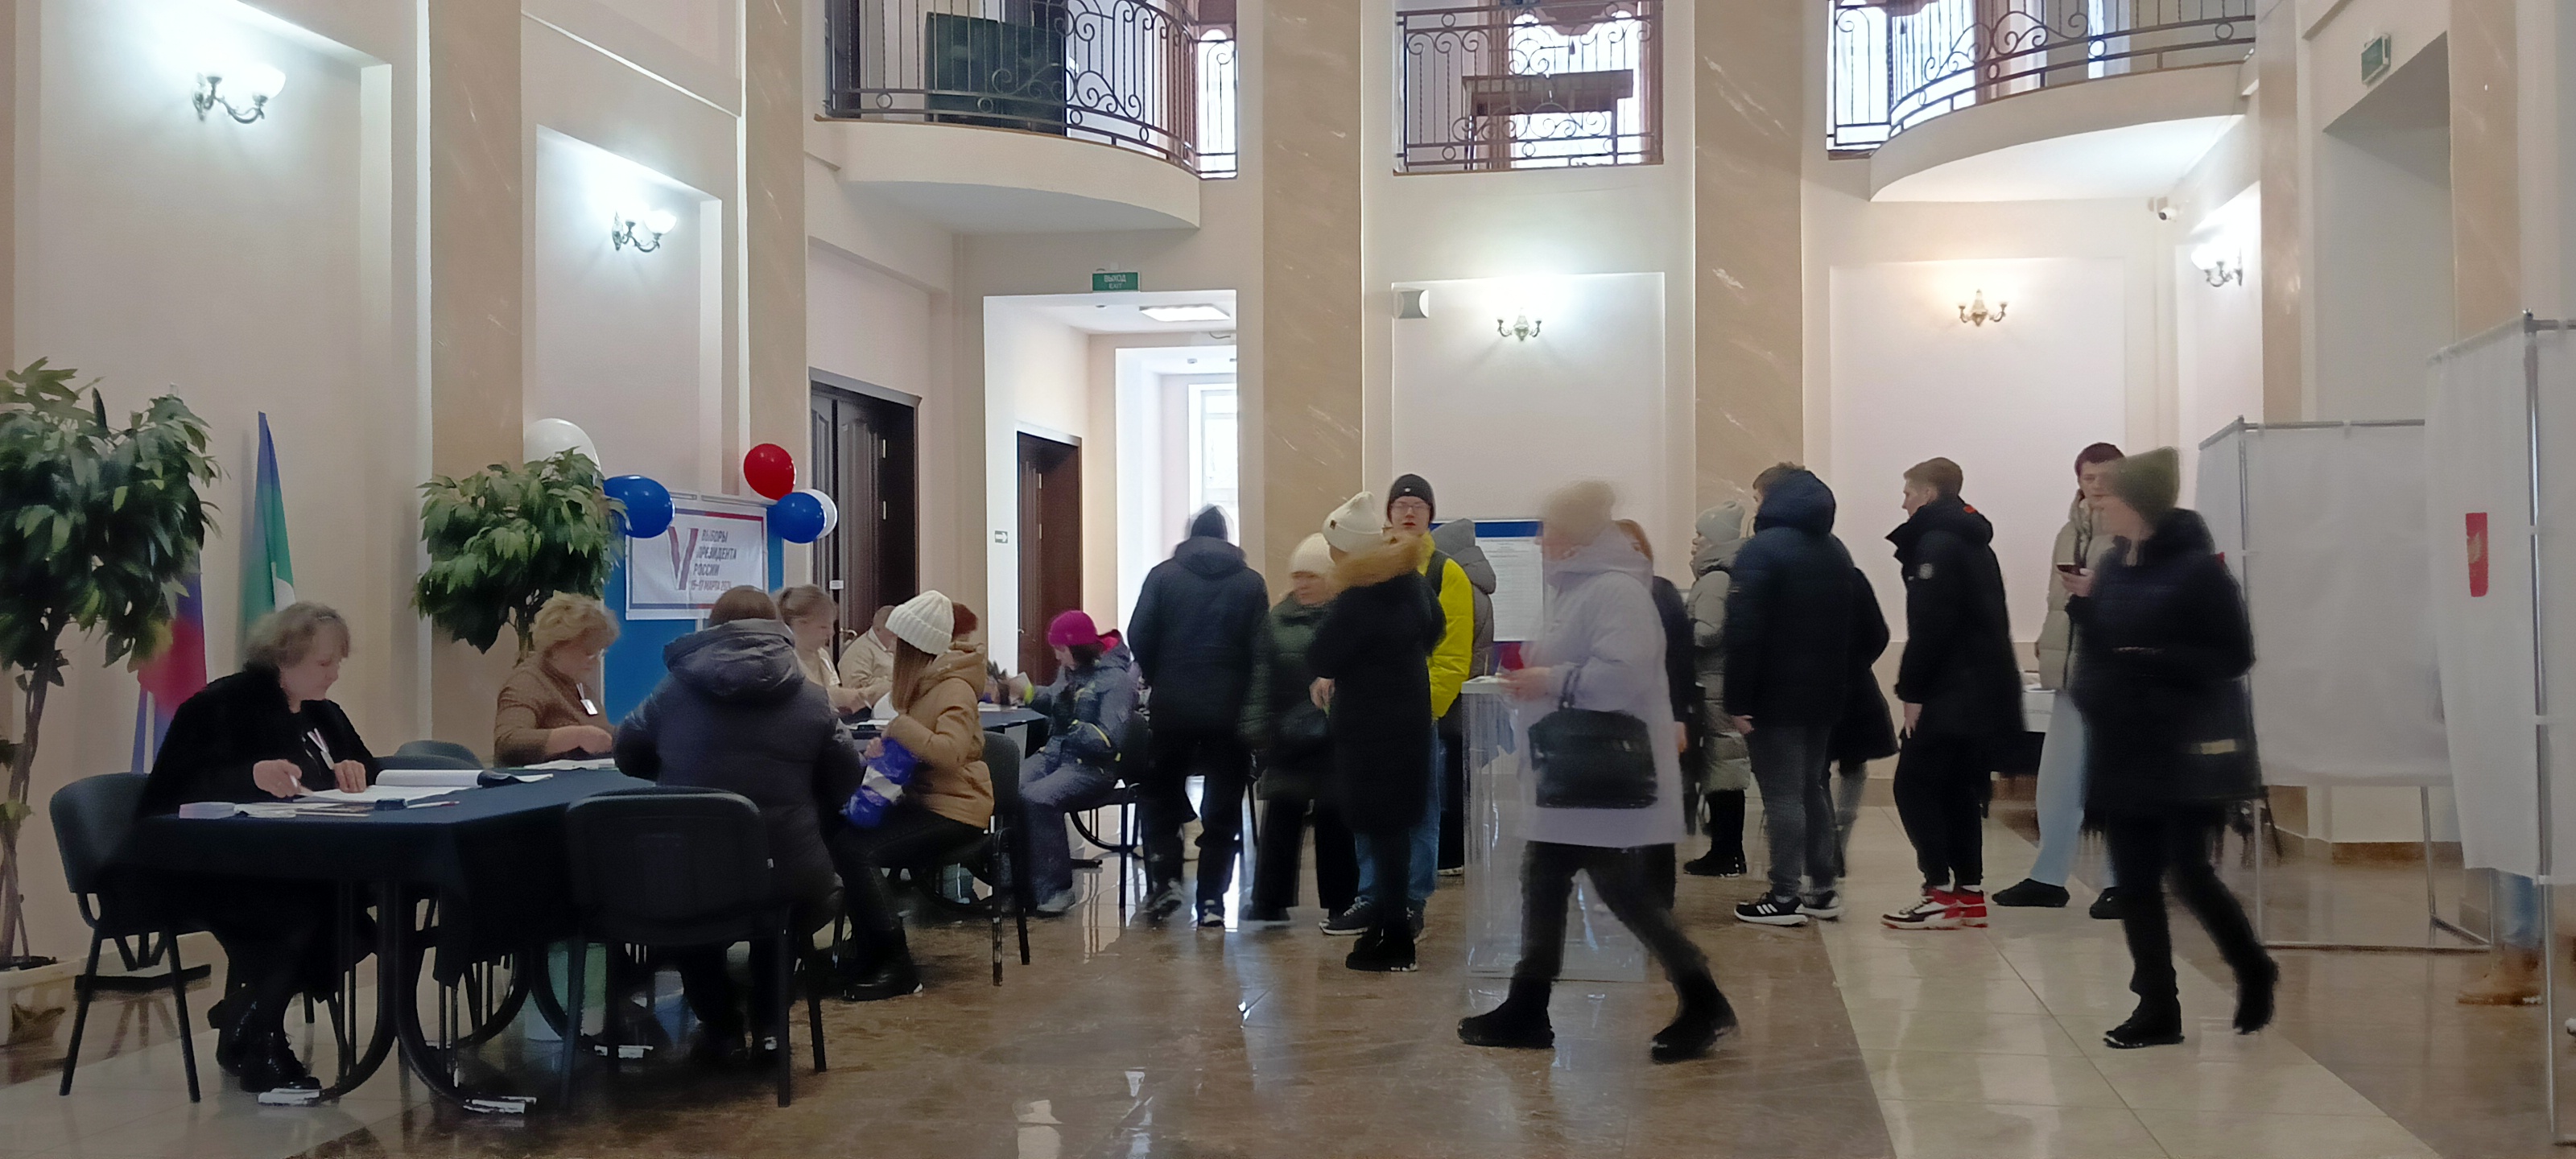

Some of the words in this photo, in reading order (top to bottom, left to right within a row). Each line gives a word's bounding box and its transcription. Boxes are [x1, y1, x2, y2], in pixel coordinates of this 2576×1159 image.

[1104, 274, 1126, 283] ВЫХОД
[701, 529, 729, 542] ВЫБОРЫ
[696, 546, 737, 561] ПРЕЗИДЕНТА
[692, 563, 720, 576] РОССИИ
